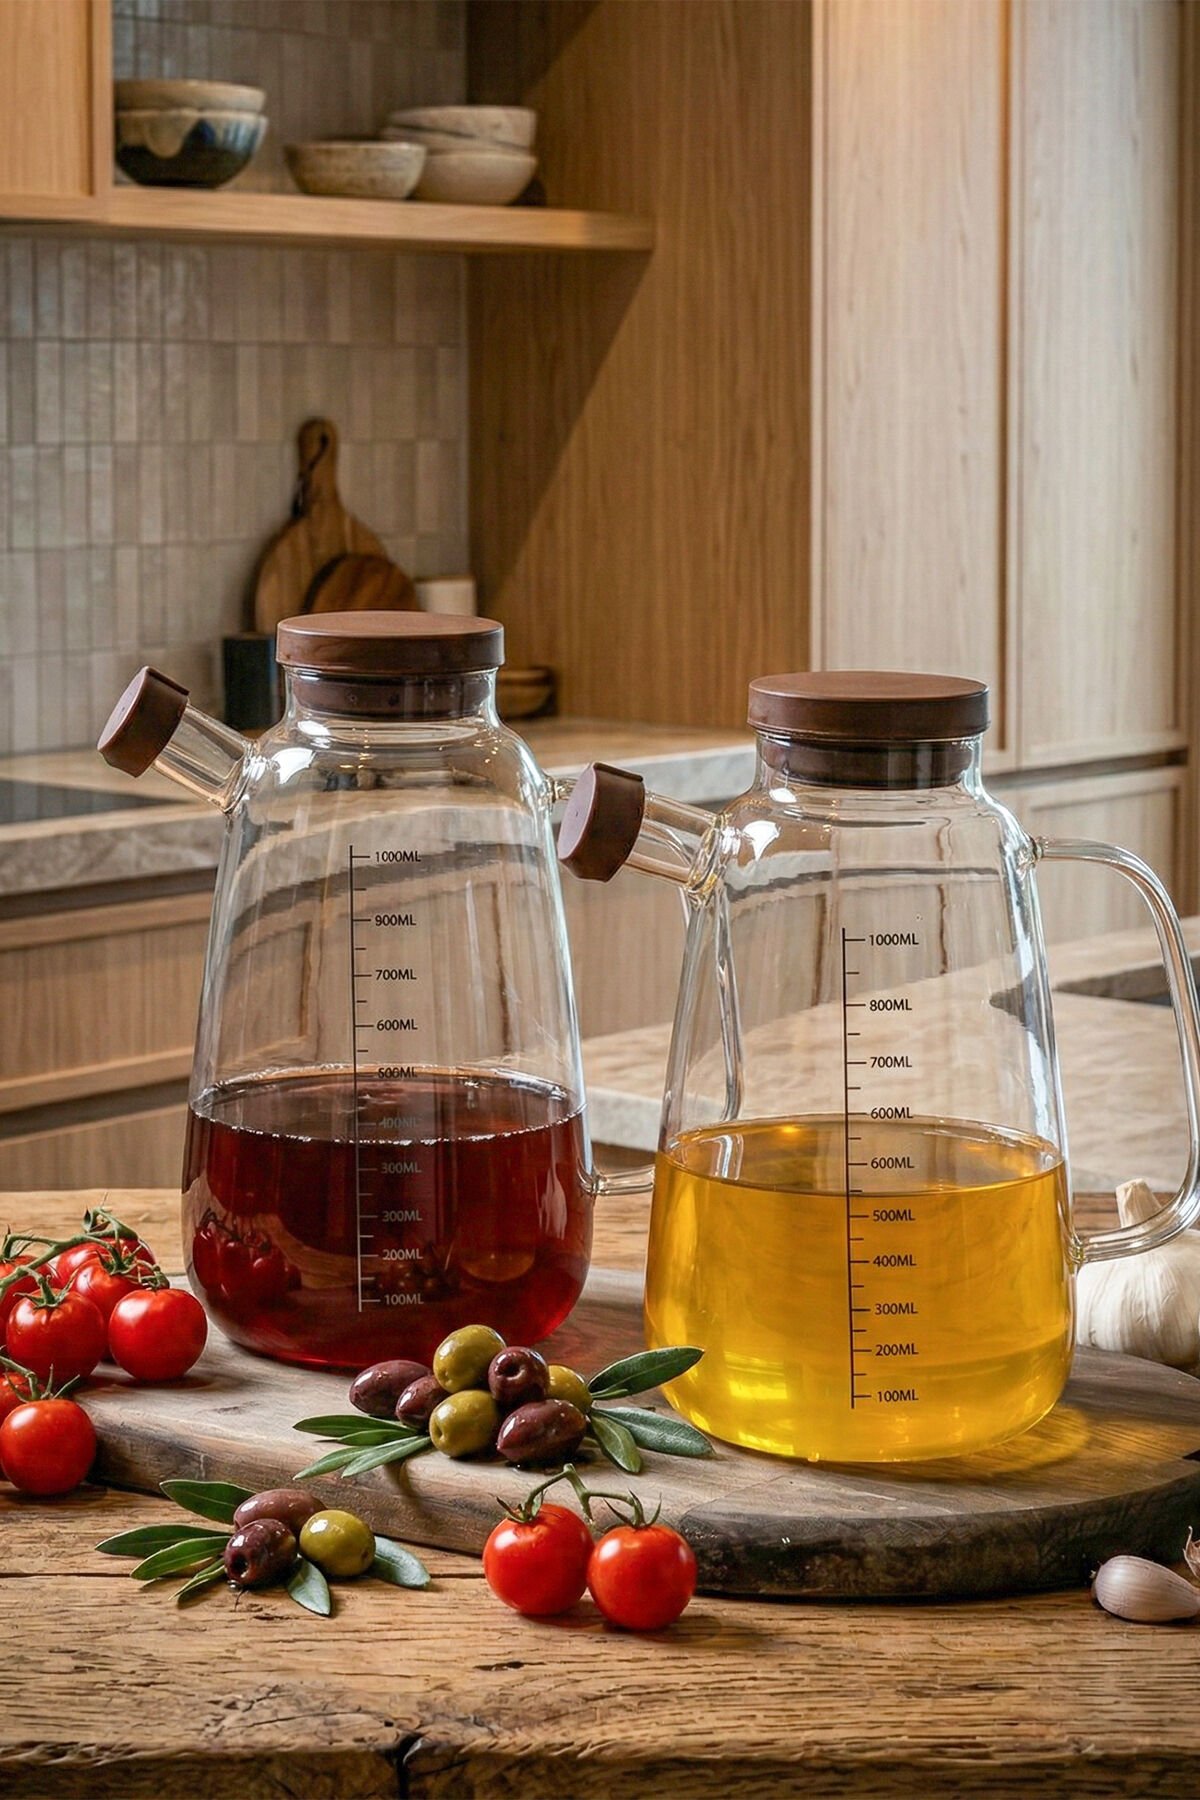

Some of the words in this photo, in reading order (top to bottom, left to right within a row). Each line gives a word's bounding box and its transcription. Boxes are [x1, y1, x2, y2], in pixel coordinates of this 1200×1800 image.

[375, 850, 421, 863] 1000ML
[375, 914, 416, 926] 900ML
[869, 933, 919, 945] 1000ML
[375, 969, 417, 981] 700ML
[869, 999, 912, 1012] 800ML
[376, 1018, 418, 1031] 600ML
[870, 1056, 912, 1068] 700ML
[870, 1107, 913, 1119] 600ML
[381, 1162, 422, 1174] 300ML
[871, 1157, 914, 1169] 600ML
[382, 1210, 422, 1222] 300ML
[872, 1209, 915, 1222] 500ML
[382, 1249, 423, 1260] 200ML
[873, 1255, 917, 1267] 400ML
[384, 1293, 424, 1305] 100ML
[875, 1302, 918, 1315] 300ML
[875, 1343, 918, 1356] 200ML
[877, 1389, 918, 1402] 100ML
